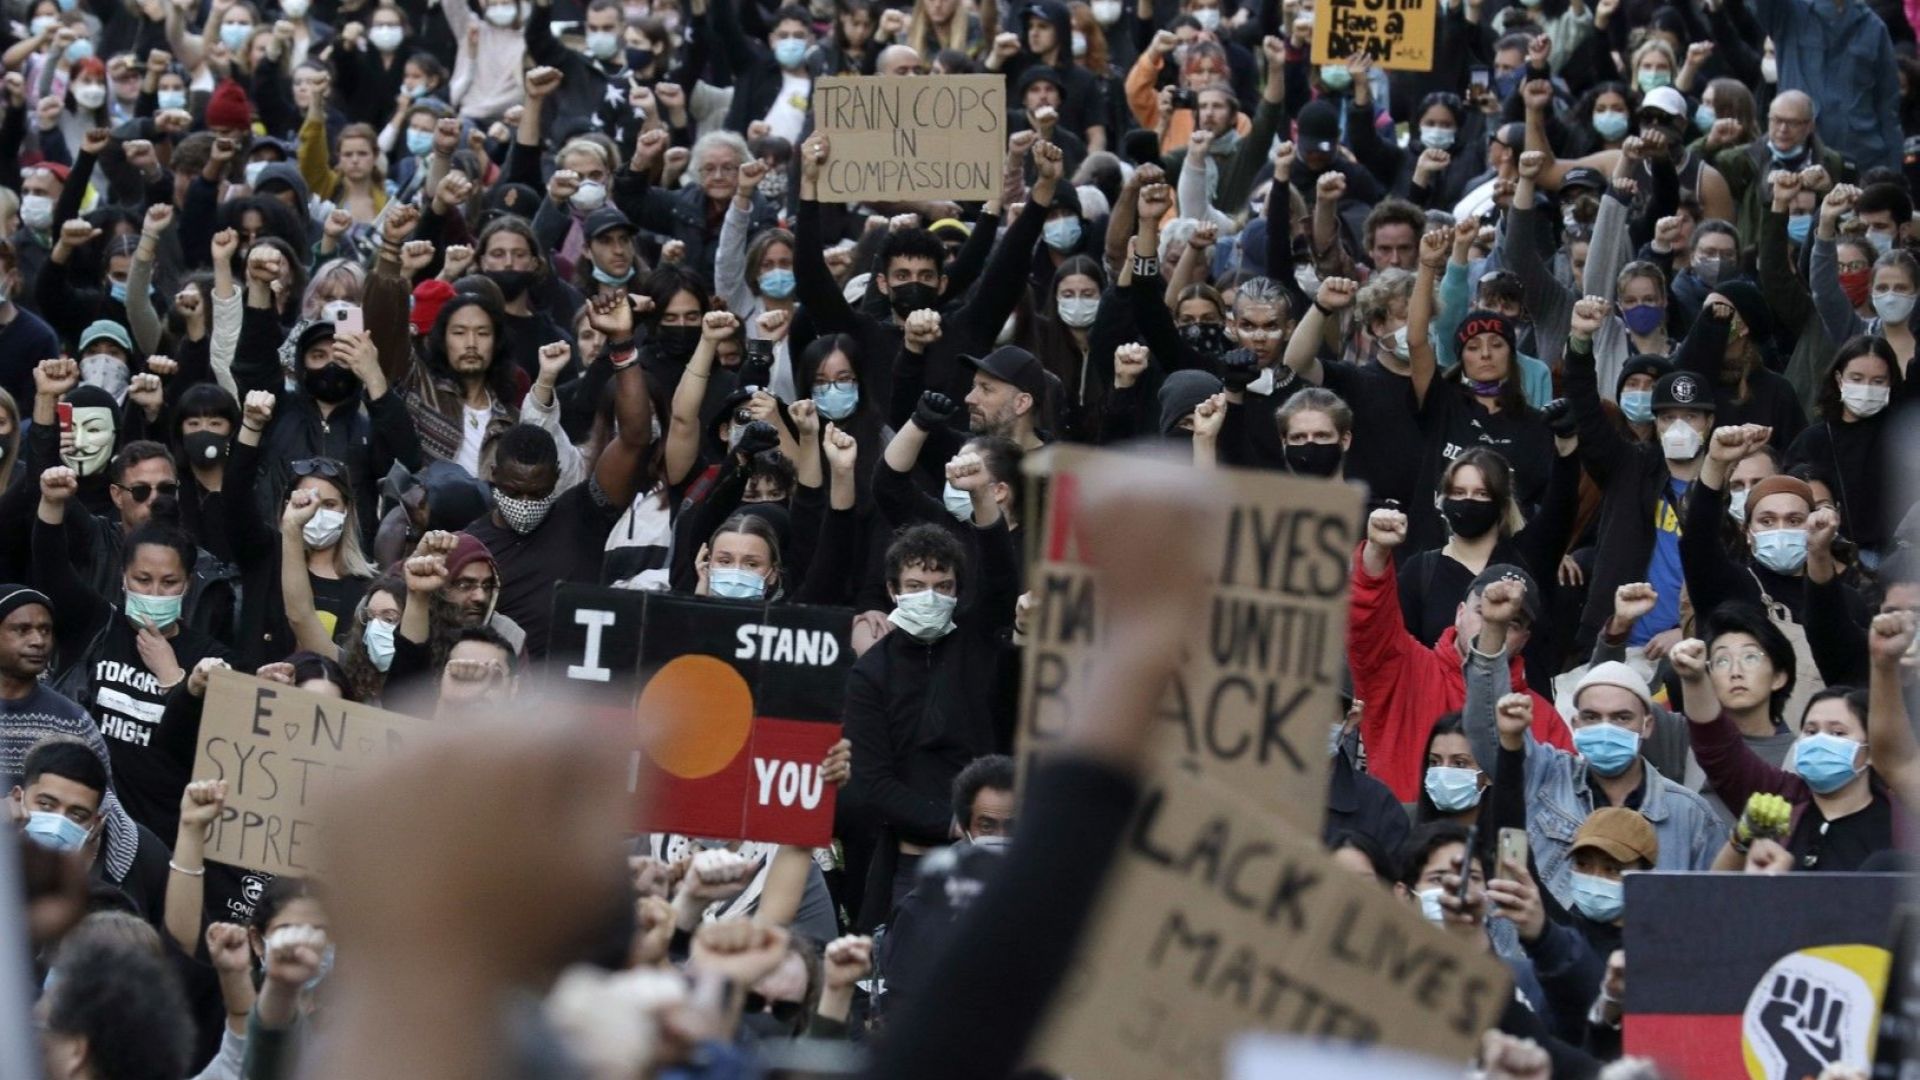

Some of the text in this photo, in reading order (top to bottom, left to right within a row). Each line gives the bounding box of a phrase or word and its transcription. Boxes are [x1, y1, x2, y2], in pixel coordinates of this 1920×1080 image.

[1331, 7, 1404, 35] Have a
[817, 85, 998, 133] TRAIN COPS
[892, 128, 917, 158] IN
[827, 159, 991, 194] COMPASSION
[1458, 319, 1504, 342] LOVE
[1218, 504, 1350, 599] IVES
[567, 608, 840, 682] I STAND
[1210, 598, 1332, 686] UNTIL
[95, 660, 162, 696] TOKOR
[101, 713, 152, 747] HIGH
[1029, 652, 1313, 773] BACK
[205, 736, 345, 806] SYST
[754, 757, 825, 810] YOU
[203, 806, 318, 870] PPRE
[1130, 791, 1490, 1036] LACK LIVES
